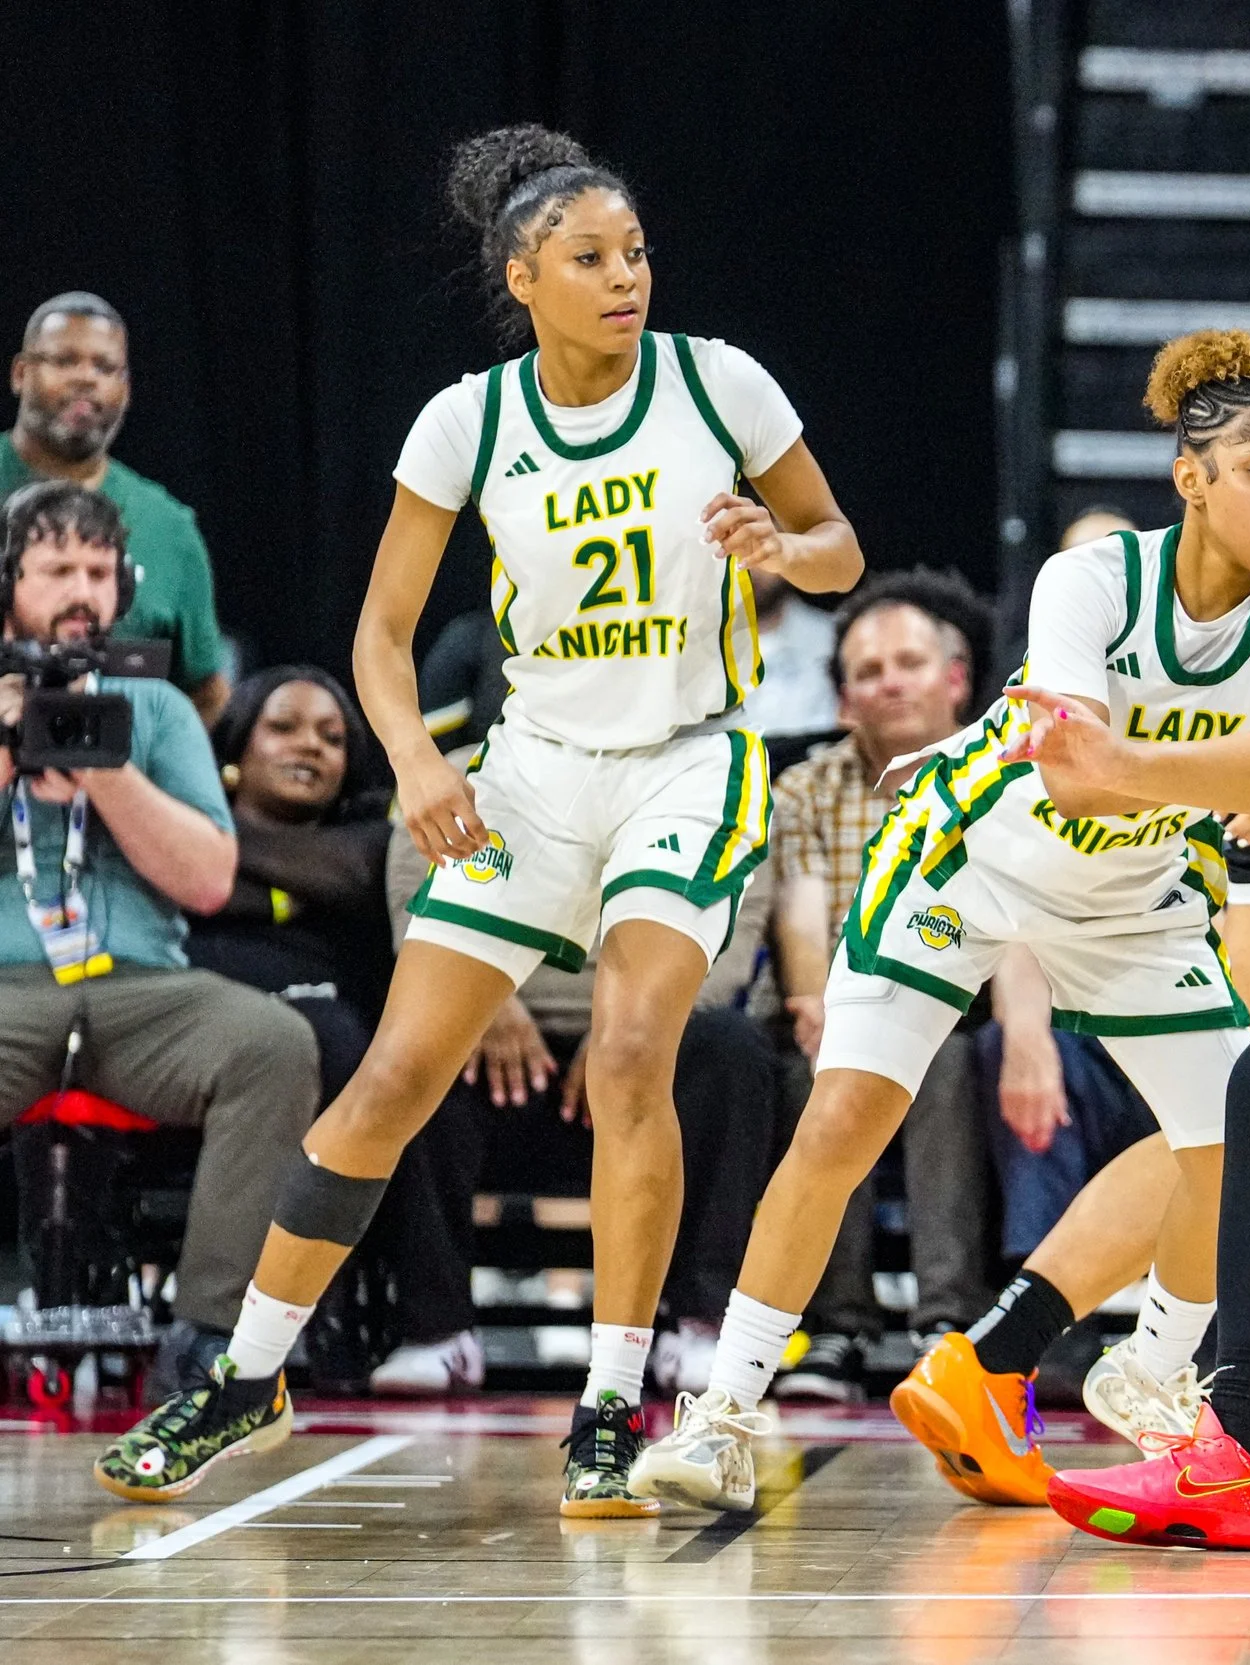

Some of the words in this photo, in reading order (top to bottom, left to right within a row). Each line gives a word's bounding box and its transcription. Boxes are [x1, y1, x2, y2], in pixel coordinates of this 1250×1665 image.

[544, 468, 659, 533] LADY
[571, 524, 656, 616] 21
[1124, 703, 1247, 743] LADY
